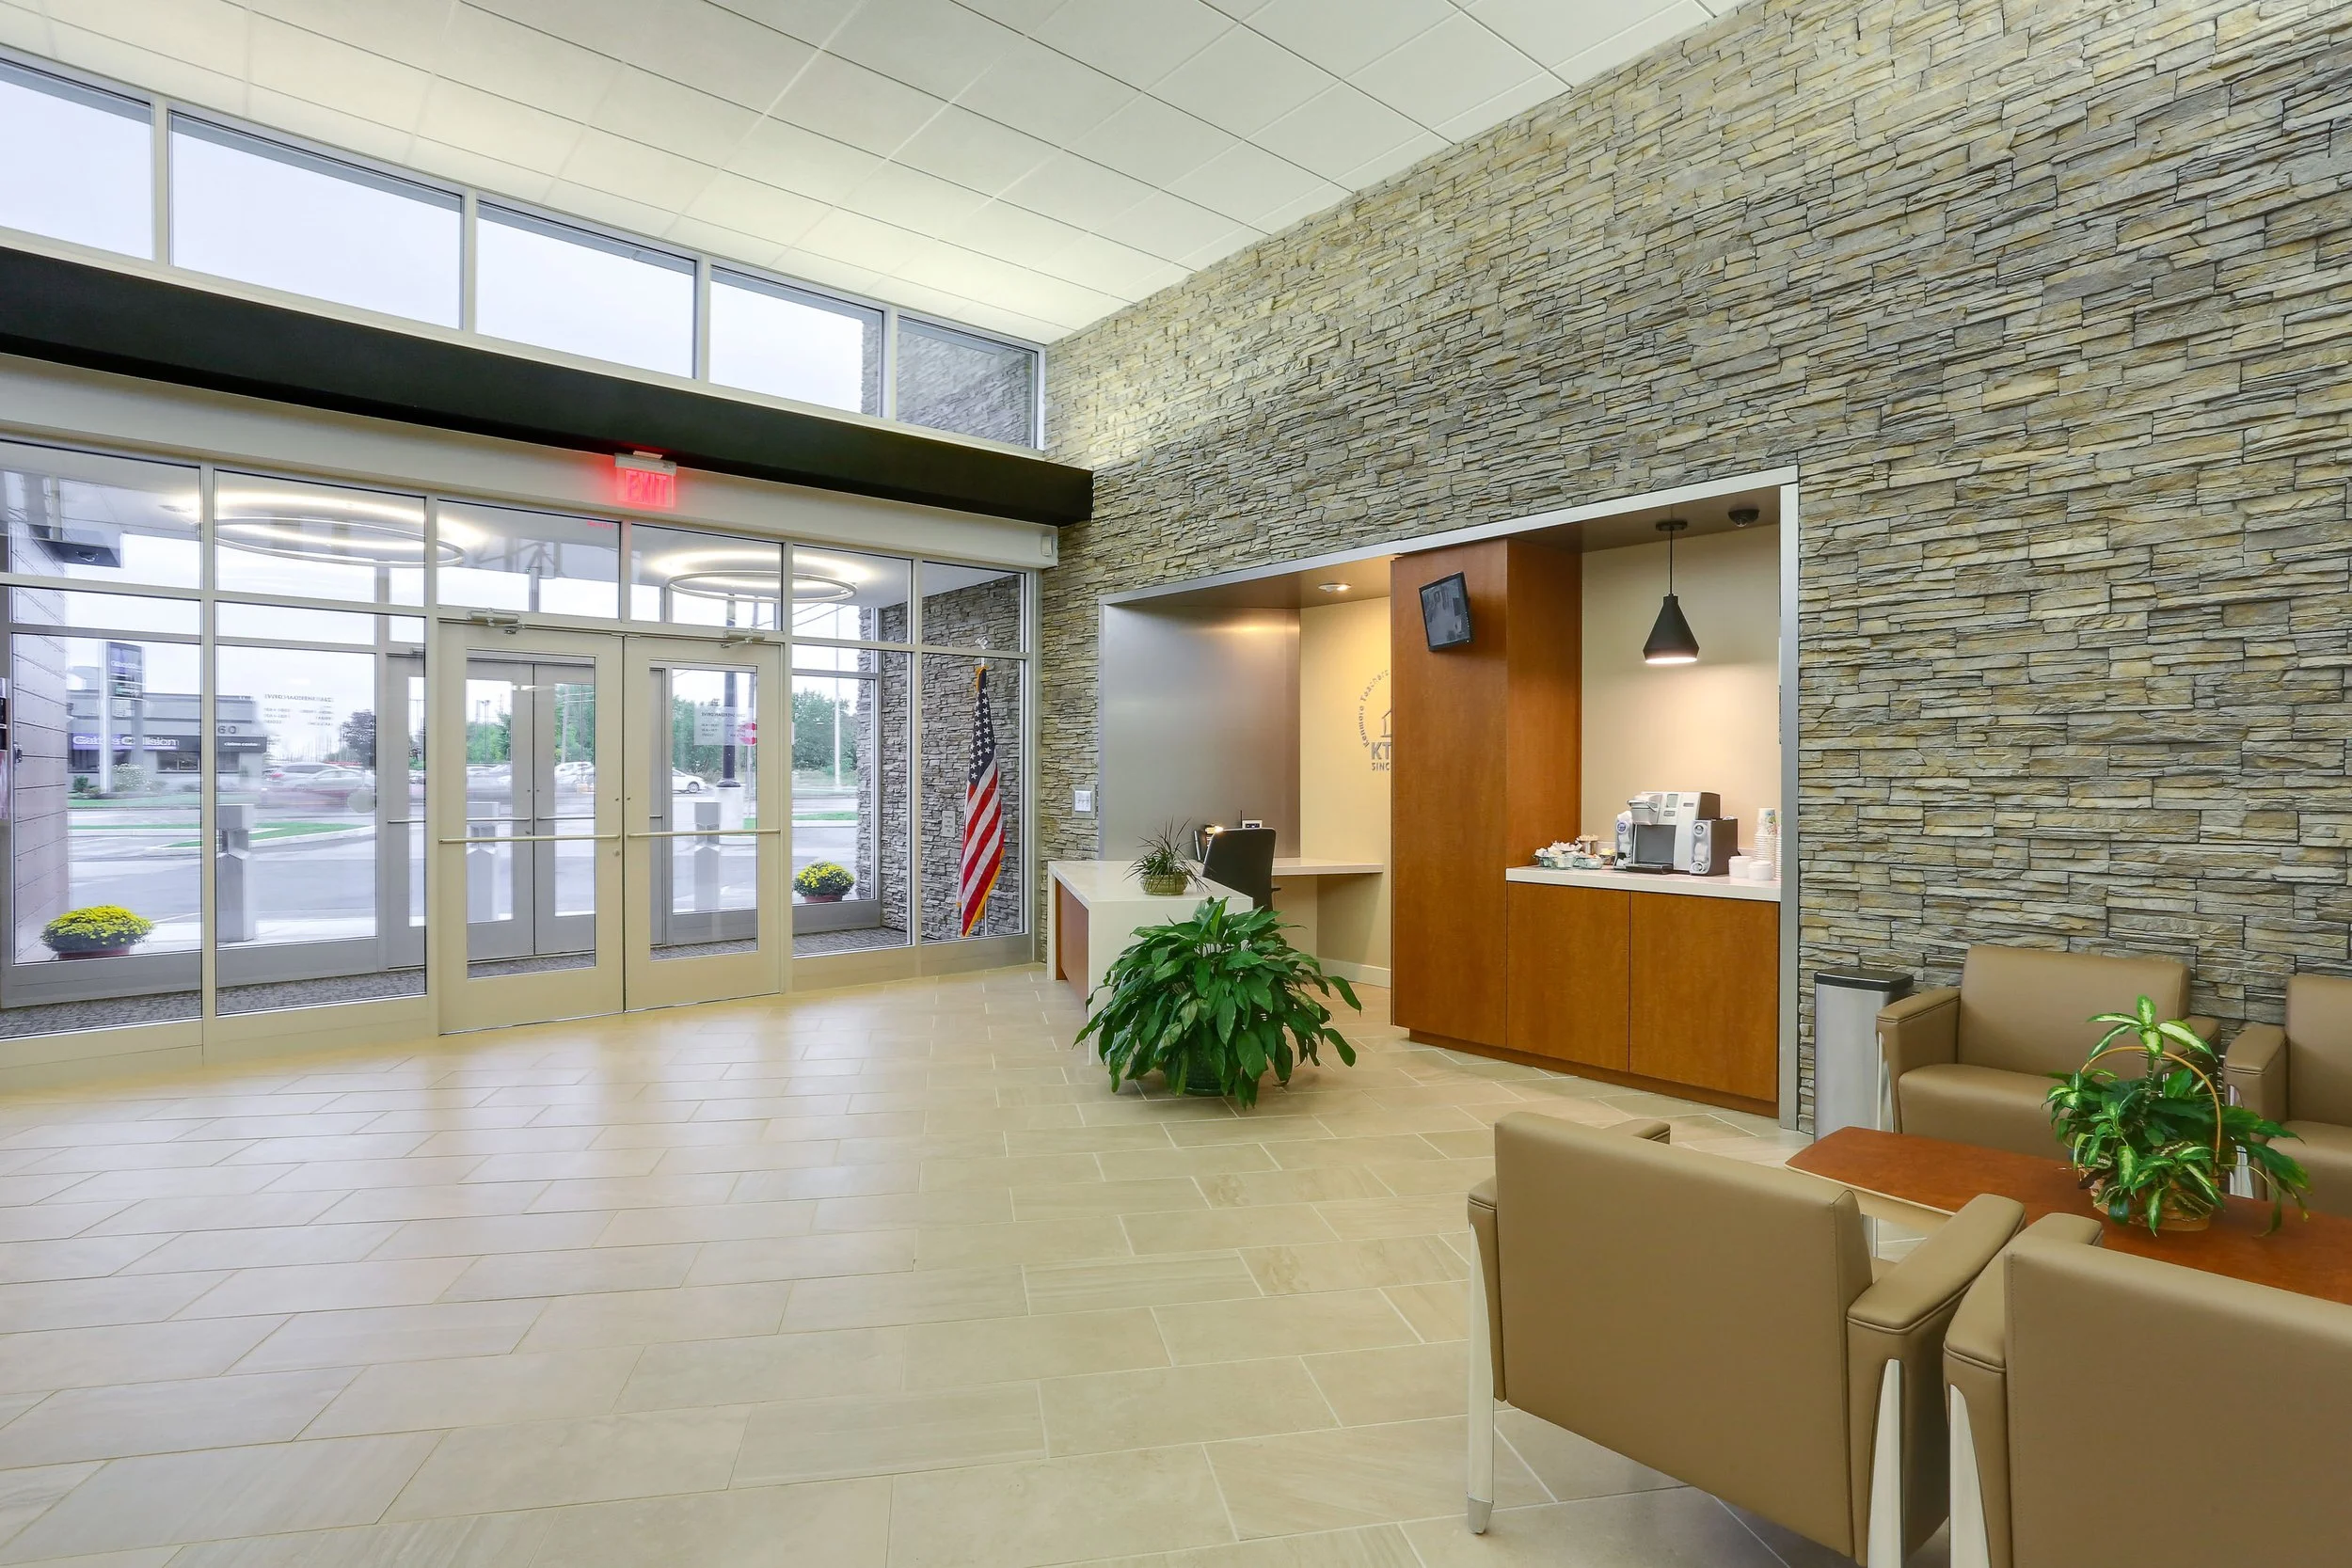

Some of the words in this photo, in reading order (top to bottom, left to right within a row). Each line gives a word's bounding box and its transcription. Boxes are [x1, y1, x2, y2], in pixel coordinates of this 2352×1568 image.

[625, 469, 667, 505] EXIT
[1359, 669, 1390, 702] Teachers
[120, 736, 180, 746] Colision
[1358, 705, 1370, 749] Kenmore
